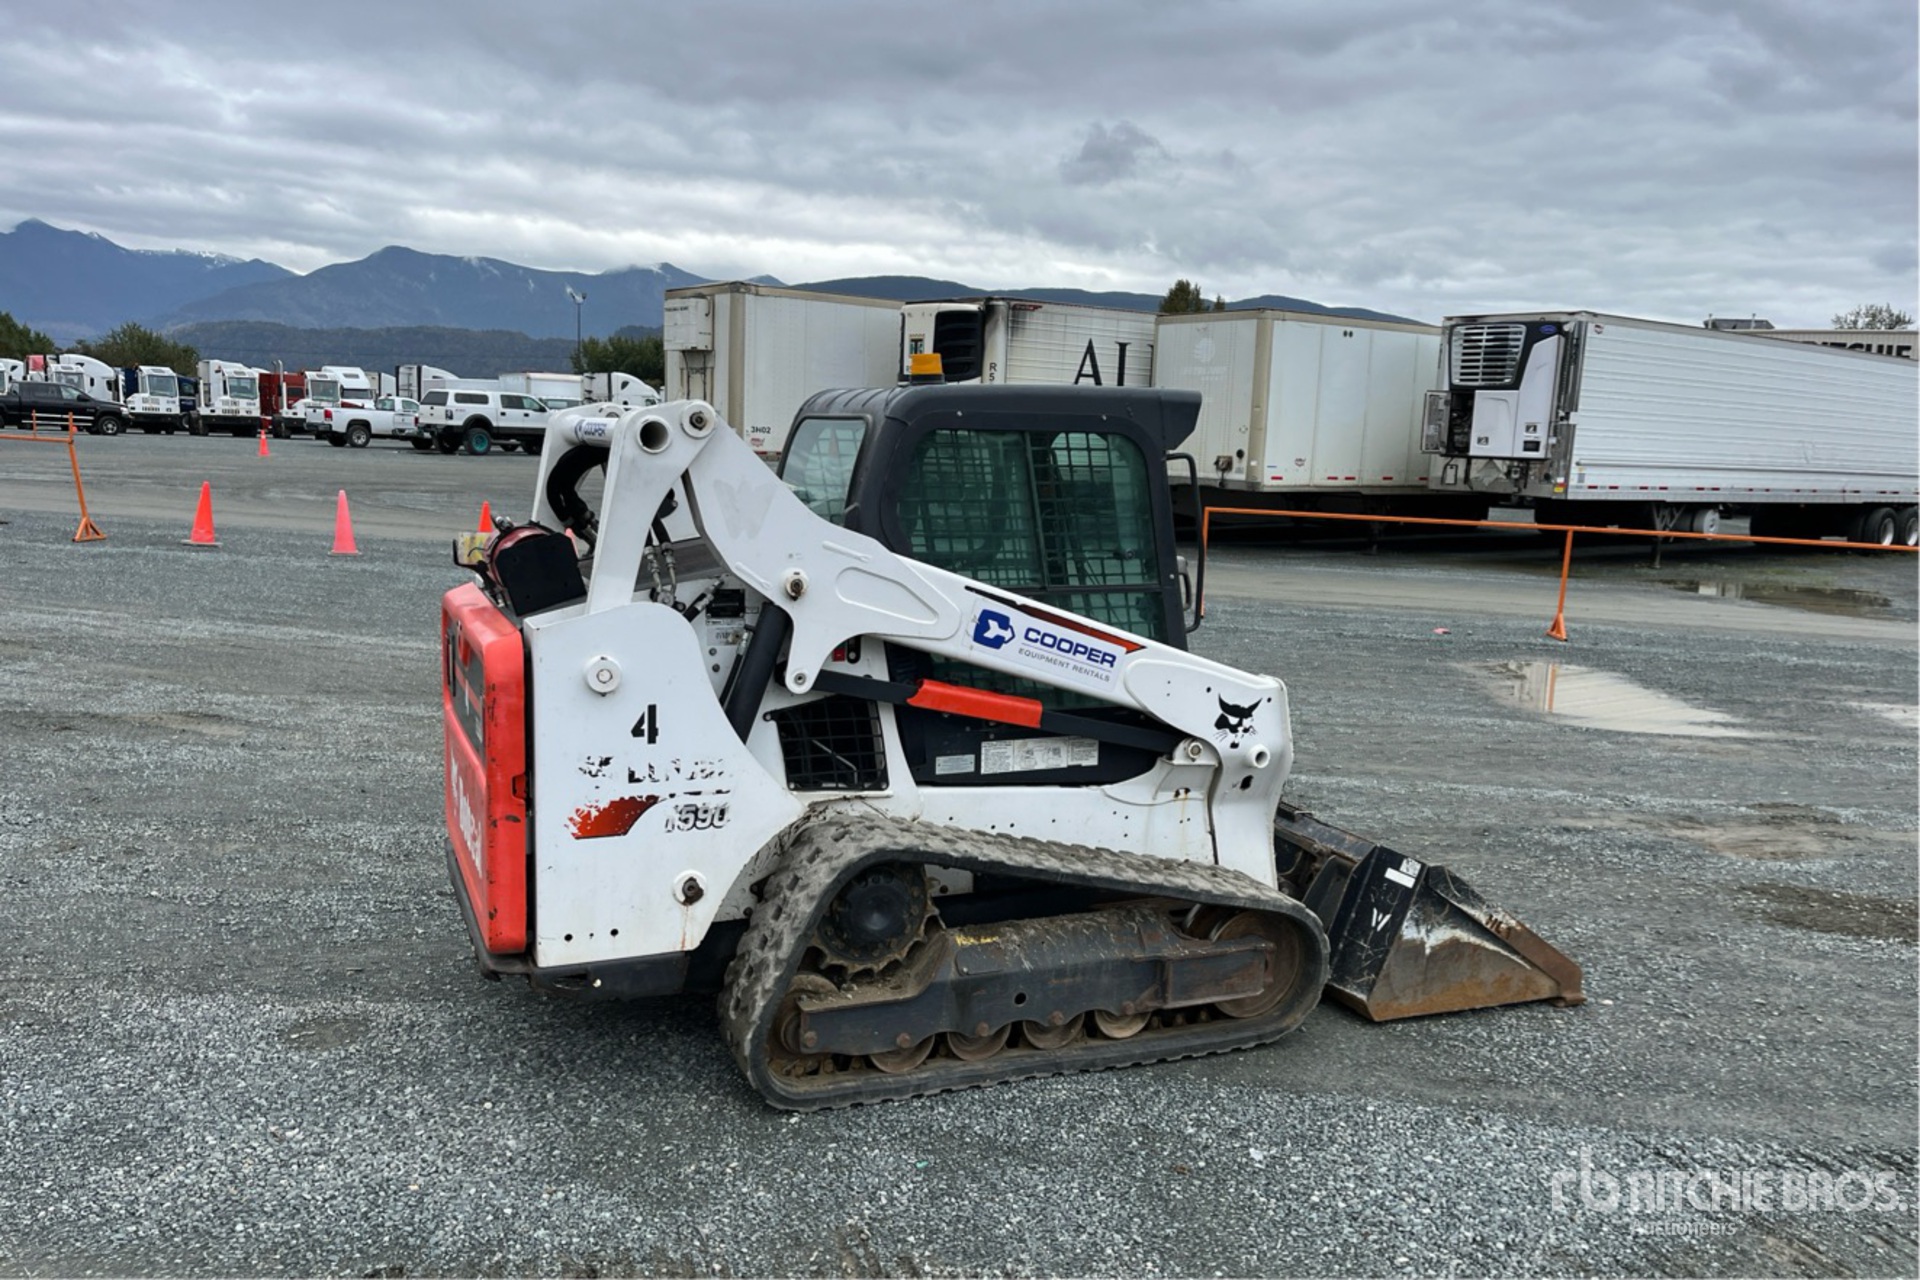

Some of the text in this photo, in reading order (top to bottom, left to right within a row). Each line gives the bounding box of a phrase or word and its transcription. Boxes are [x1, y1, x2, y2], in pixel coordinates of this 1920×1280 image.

[1018, 648, 1110, 682] EQUIPMENT RENTALS
[1023, 627, 1117, 668] COOPER
[631, 704, 659, 744] 4
